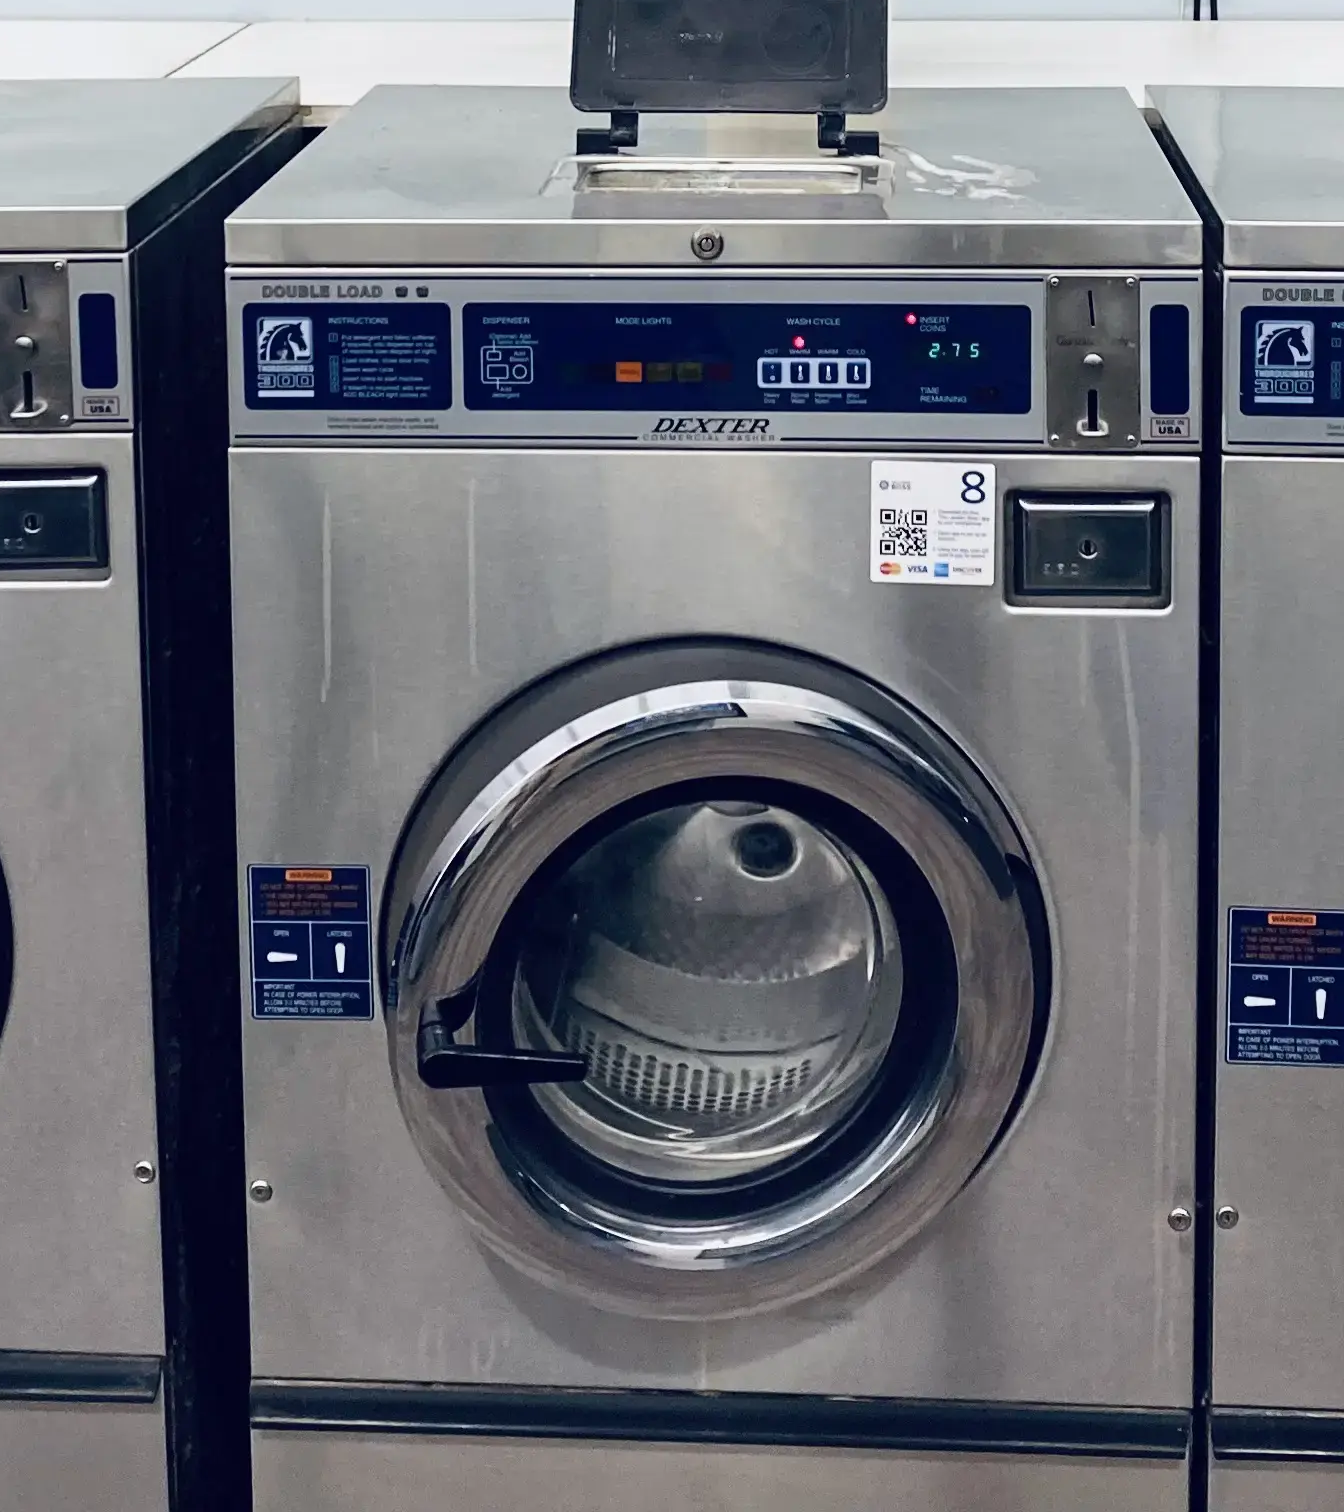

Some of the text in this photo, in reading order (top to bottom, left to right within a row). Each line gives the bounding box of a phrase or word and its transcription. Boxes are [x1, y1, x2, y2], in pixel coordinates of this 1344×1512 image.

[261, 285, 384, 299] DOUBLE LOAD
[1262, 287, 1335, 302] DOUBLE
[327, 317, 390, 326] INSTRUCTIONS
[482, 316, 531, 325] DISPENSER
[615, 317, 673, 326] MODE LIGHTS
[786, 317, 841, 326] WASH CYCLE
[919, 316, 950, 324] INSERT
[919, 324, 947, 333] COINS
[919, 387, 940, 395] TIME
[919, 395, 968, 404] REMAINING
[651, 417, 771, 434] DEXTER
[1158, 426, 1182, 435] USA
[960, 470, 987, 504] 8
[907, 565, 929, 574] VISA
